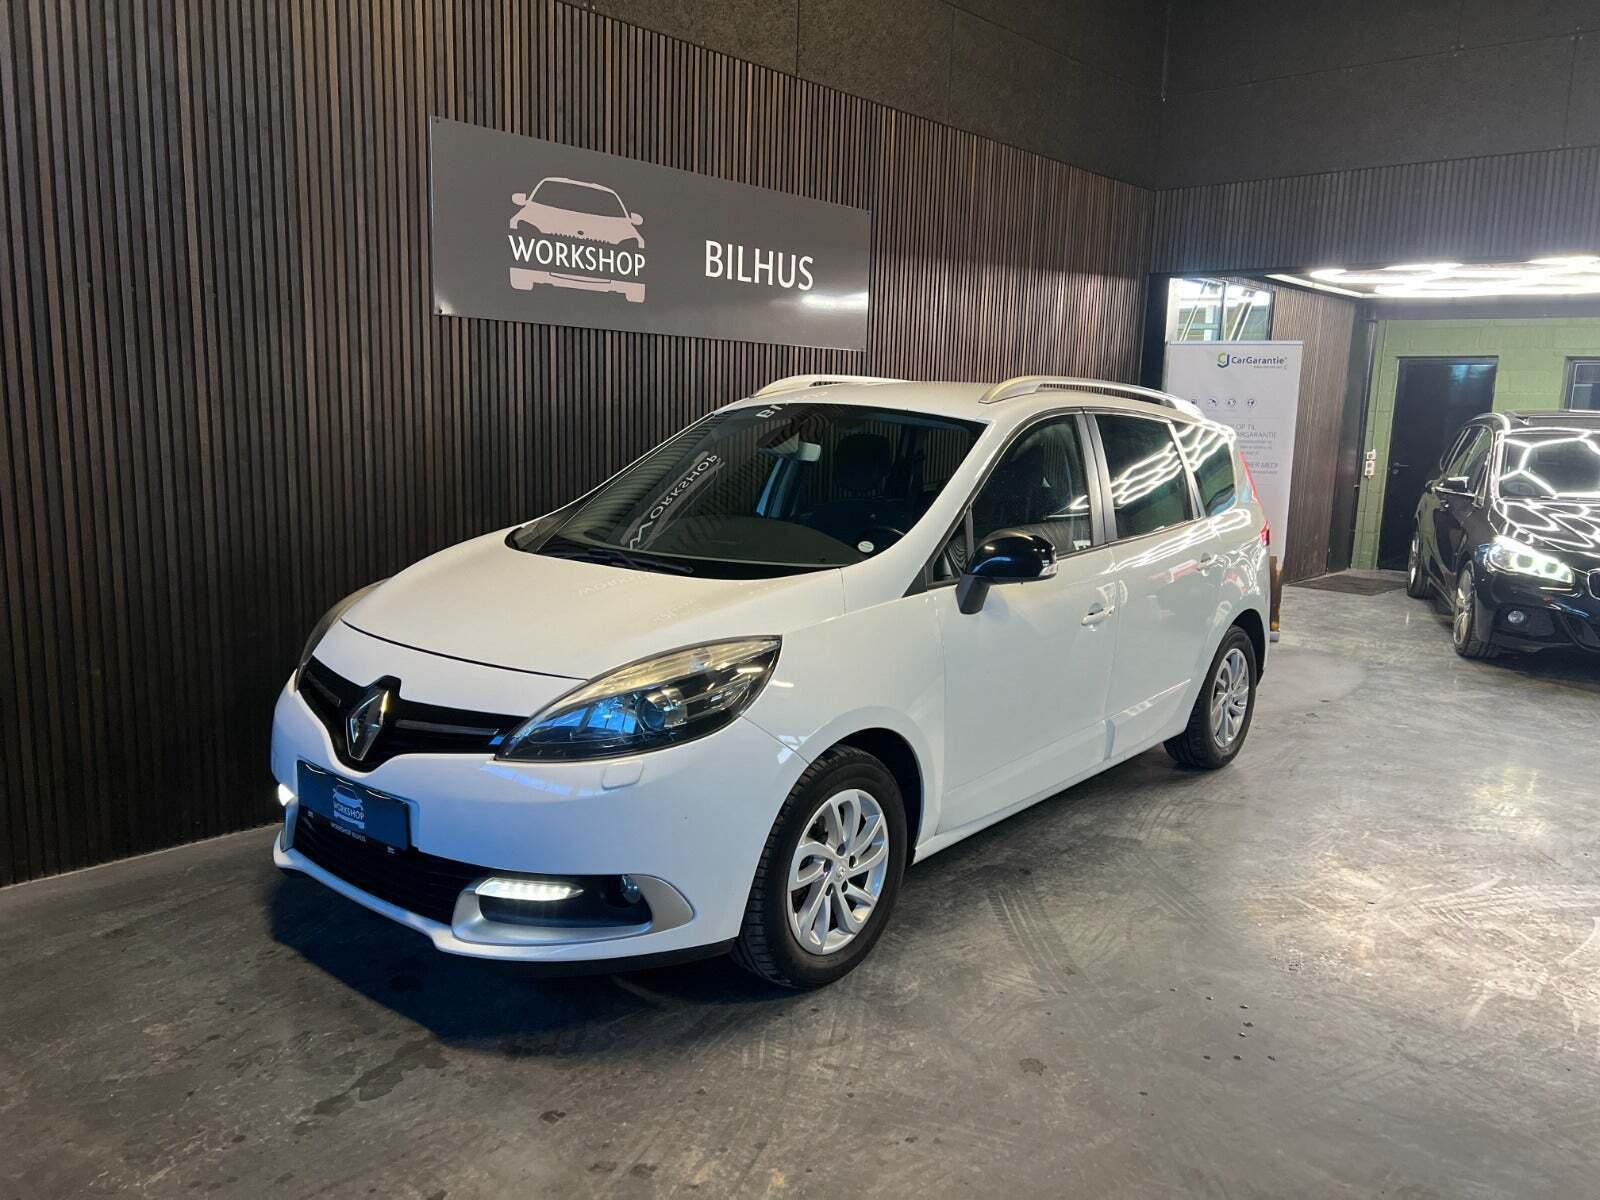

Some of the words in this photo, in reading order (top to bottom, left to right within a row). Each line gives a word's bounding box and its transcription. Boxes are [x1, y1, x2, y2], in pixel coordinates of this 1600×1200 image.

[508, 235, 646, 277] WORKSHOP
[705, 240, 814, 291] BILHUS
[1231, 356, 1286, 365] CarGarantie
